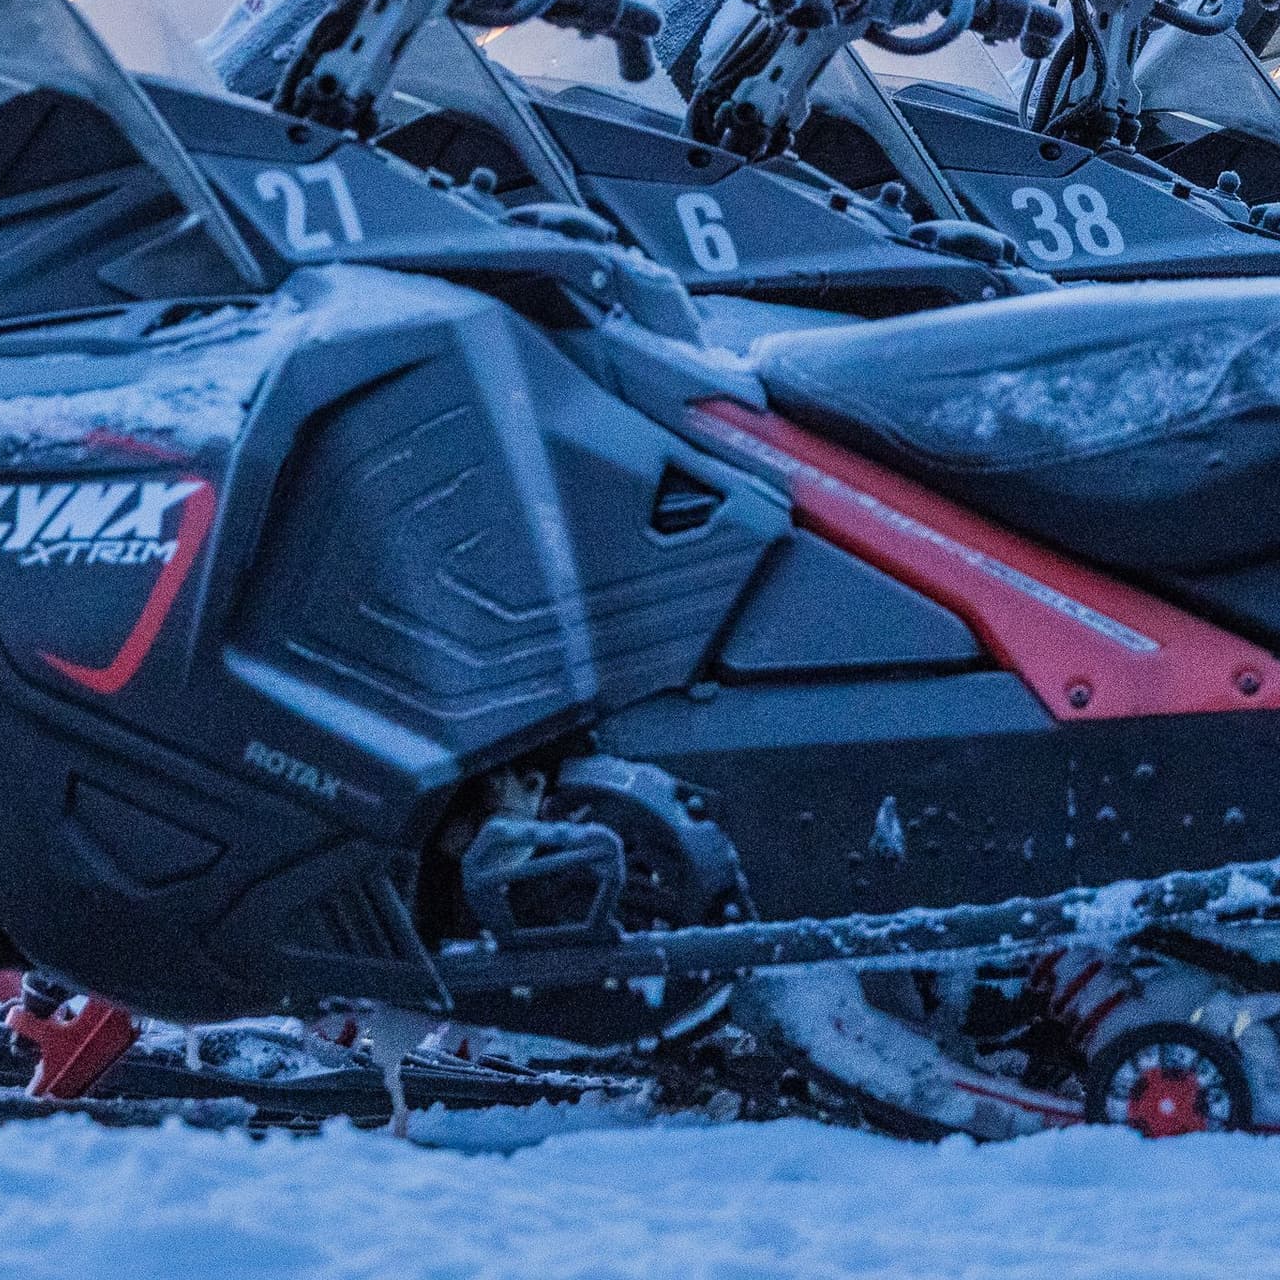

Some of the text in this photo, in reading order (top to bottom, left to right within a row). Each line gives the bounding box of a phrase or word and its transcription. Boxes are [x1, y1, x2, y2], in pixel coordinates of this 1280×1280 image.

[255, 159, 363, 252] 27
[676, 193, 737, 271] 6
[1011, 183, 1124, 261] 38
[21, 541, 178, 566] XTRIM
[243, 740, 341, 800] ROTAX
